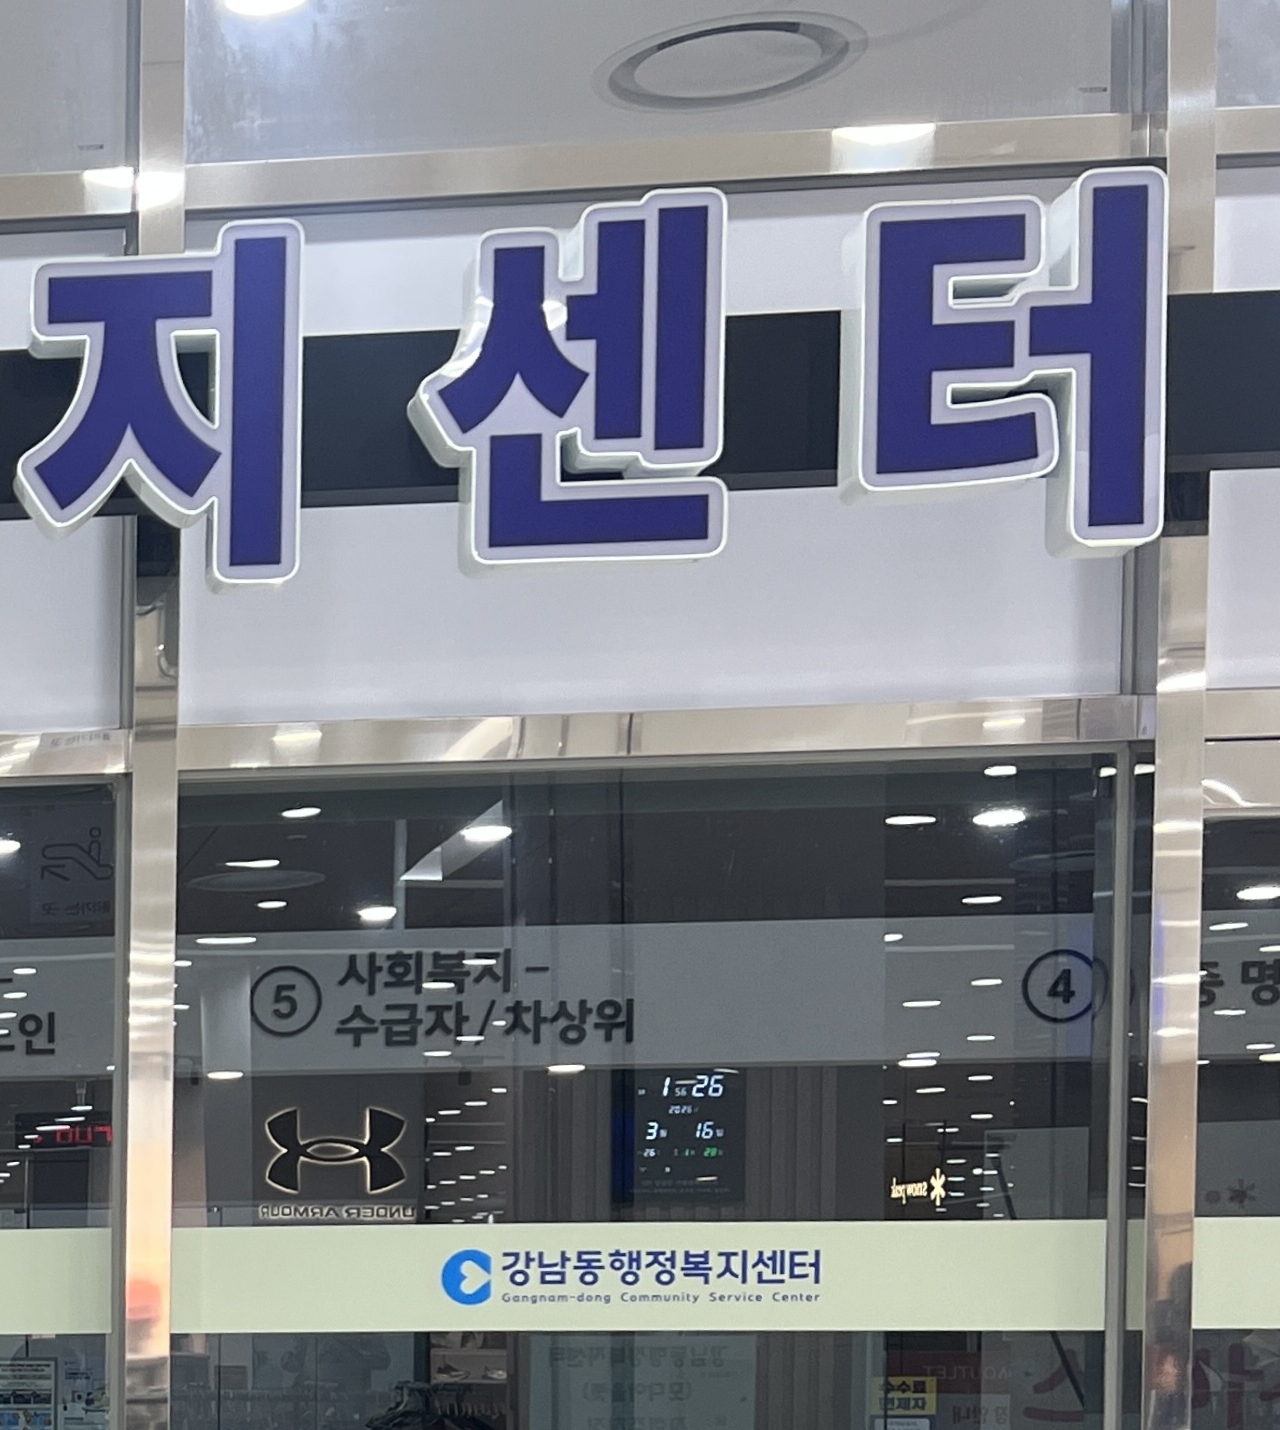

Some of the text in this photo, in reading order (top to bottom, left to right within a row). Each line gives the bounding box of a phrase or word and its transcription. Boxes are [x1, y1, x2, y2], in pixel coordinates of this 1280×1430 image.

[336, 999, 635, 1048] 수급자/차상위
[501, 1249, 822, 1286] 강남동행정복지센터
[501, 1291, 822, 1305] Gangnam-dong Community Service Center
